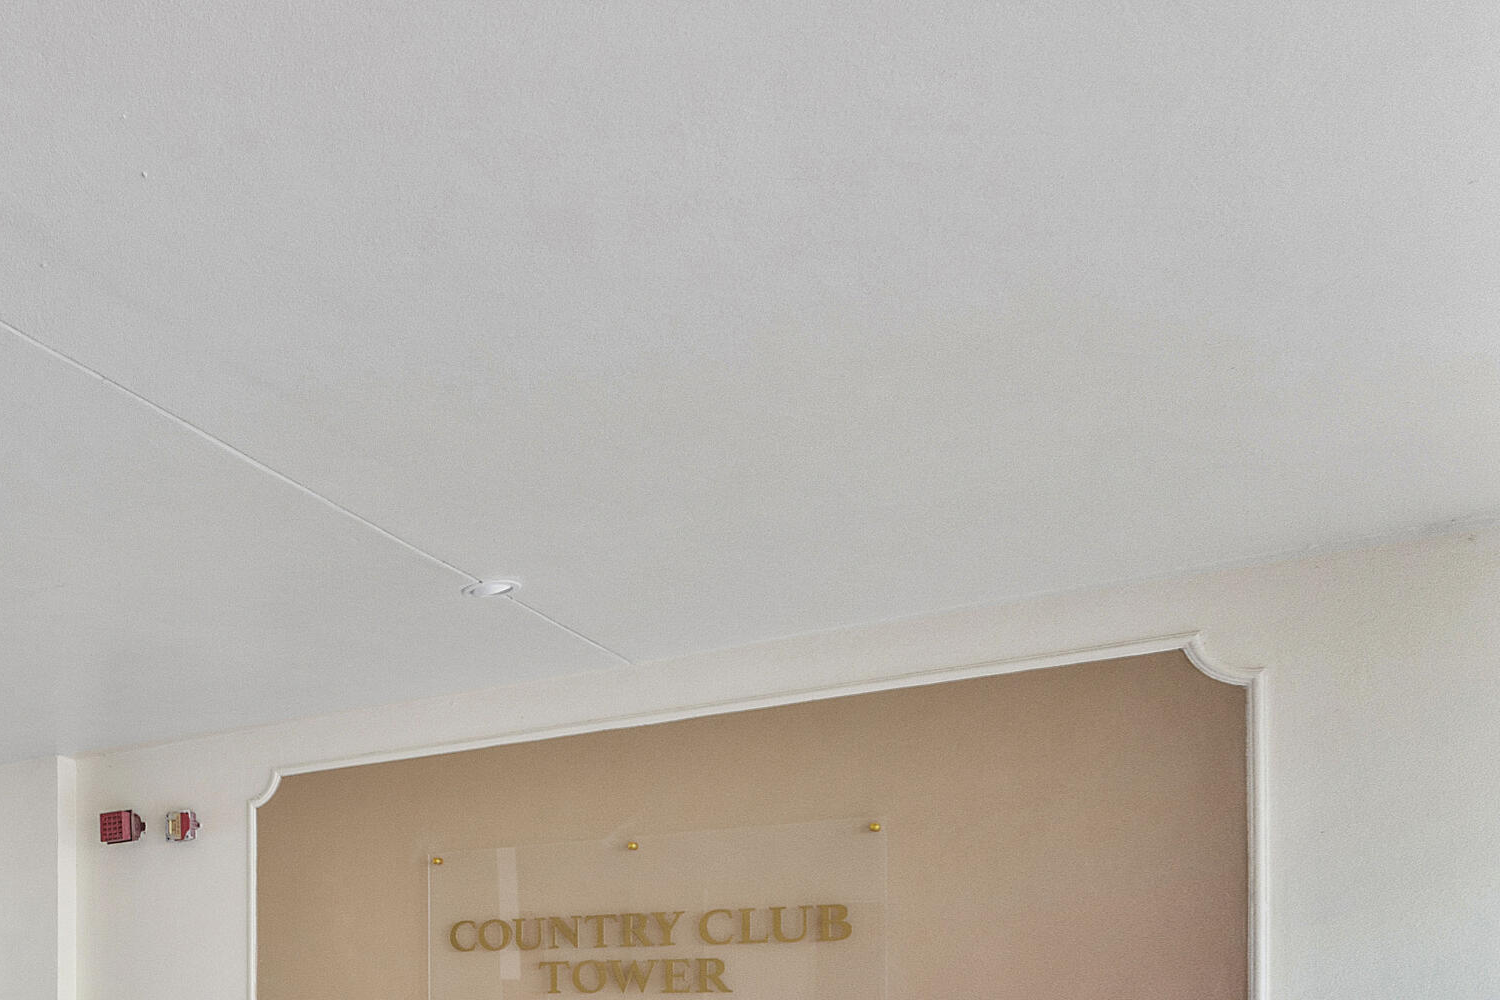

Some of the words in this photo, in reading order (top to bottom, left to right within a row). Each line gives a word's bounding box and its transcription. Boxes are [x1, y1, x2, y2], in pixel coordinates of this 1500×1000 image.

[448, 910, 685, 952] COUNTRY
[699, 903, 853, 945] CLUB
[538, 957, 733, 994] TOWER
